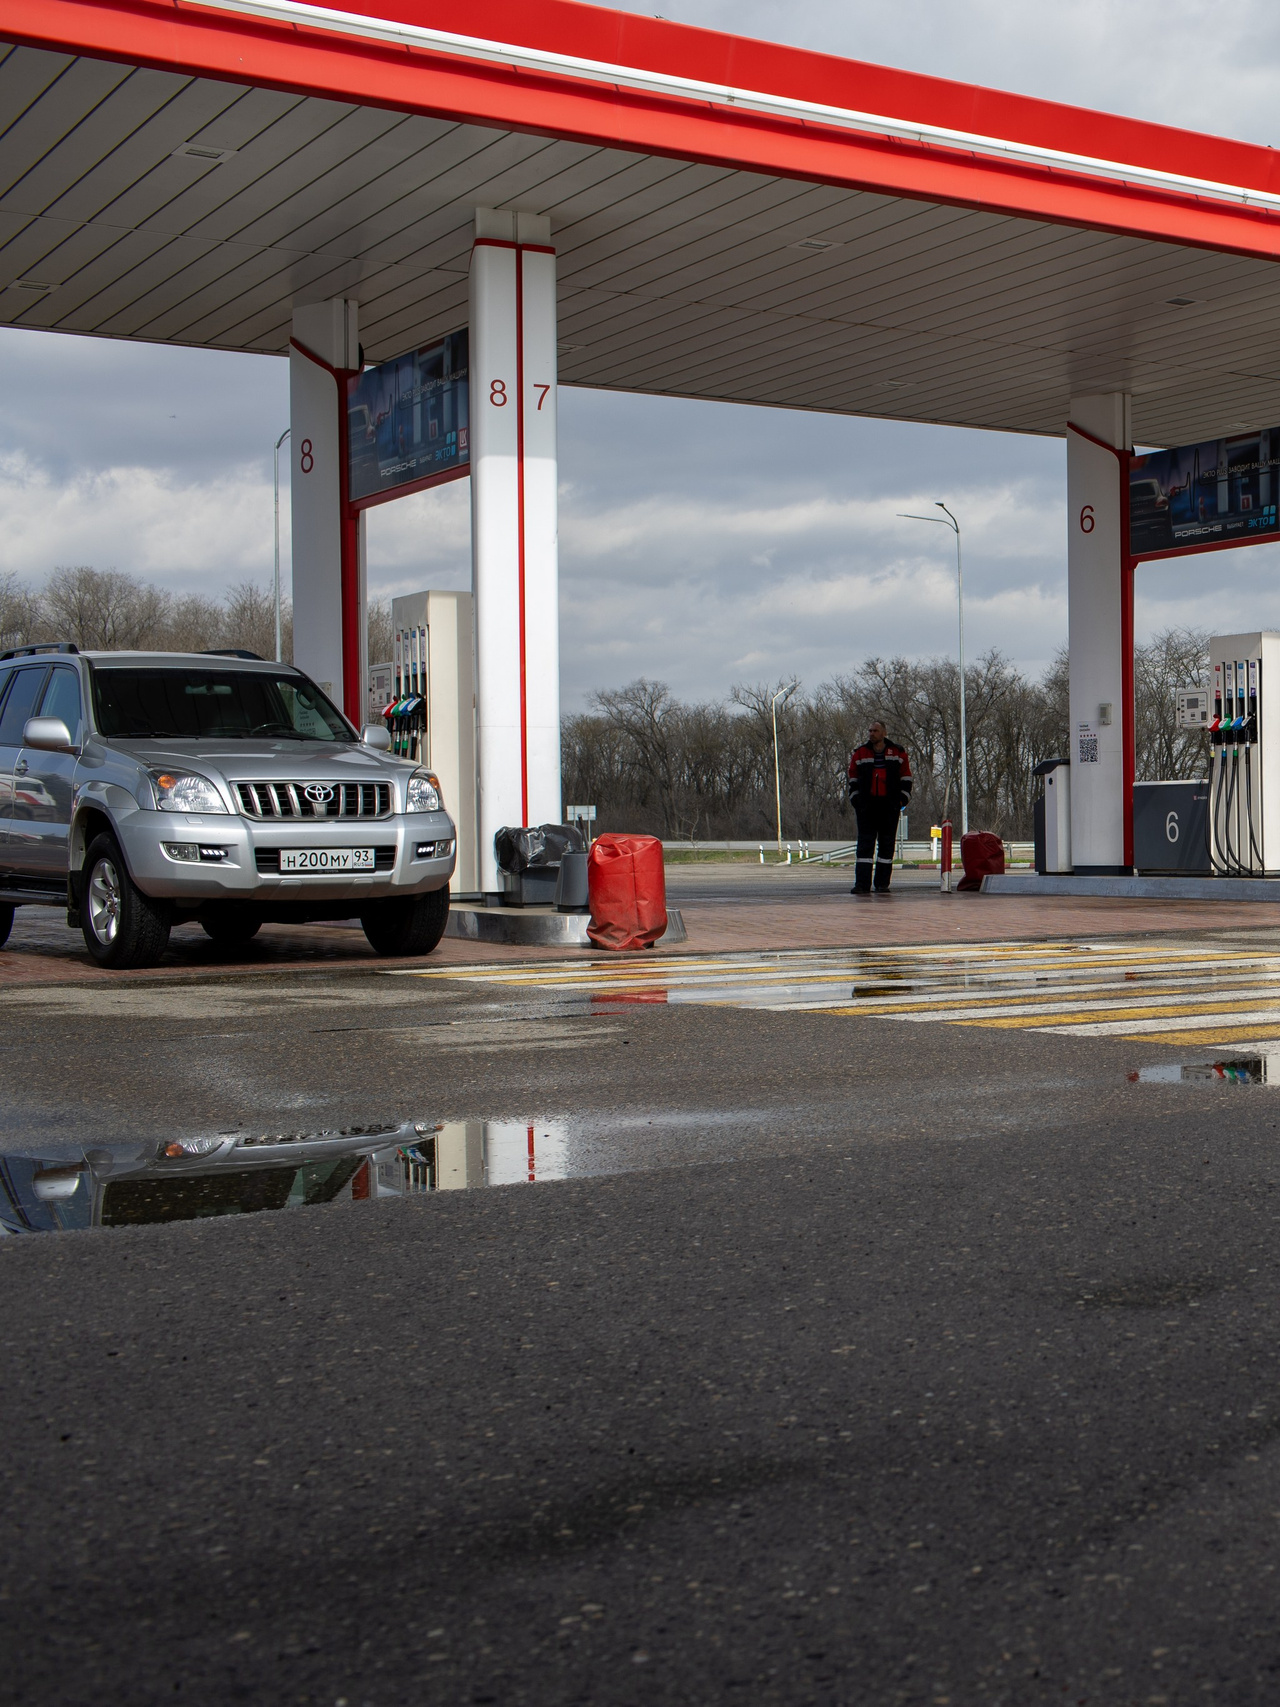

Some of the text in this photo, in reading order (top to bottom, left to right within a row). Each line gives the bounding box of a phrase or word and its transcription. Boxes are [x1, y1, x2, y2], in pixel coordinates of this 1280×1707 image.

[490, 379, 507, 407] 8
[533, 384, 550, 410] 7
[301, 439, 313, 473] 8
[380, 459, 416, 476] PORSCHE
[1080, 505, 1094, 533] 6
[1174, 525, 1222, 538] PORSCHE
[1247, 517, 1268, 528] ЭКТО
[1166, 811, 1179, 842] 6
[354, 851, 369, 862] 93
